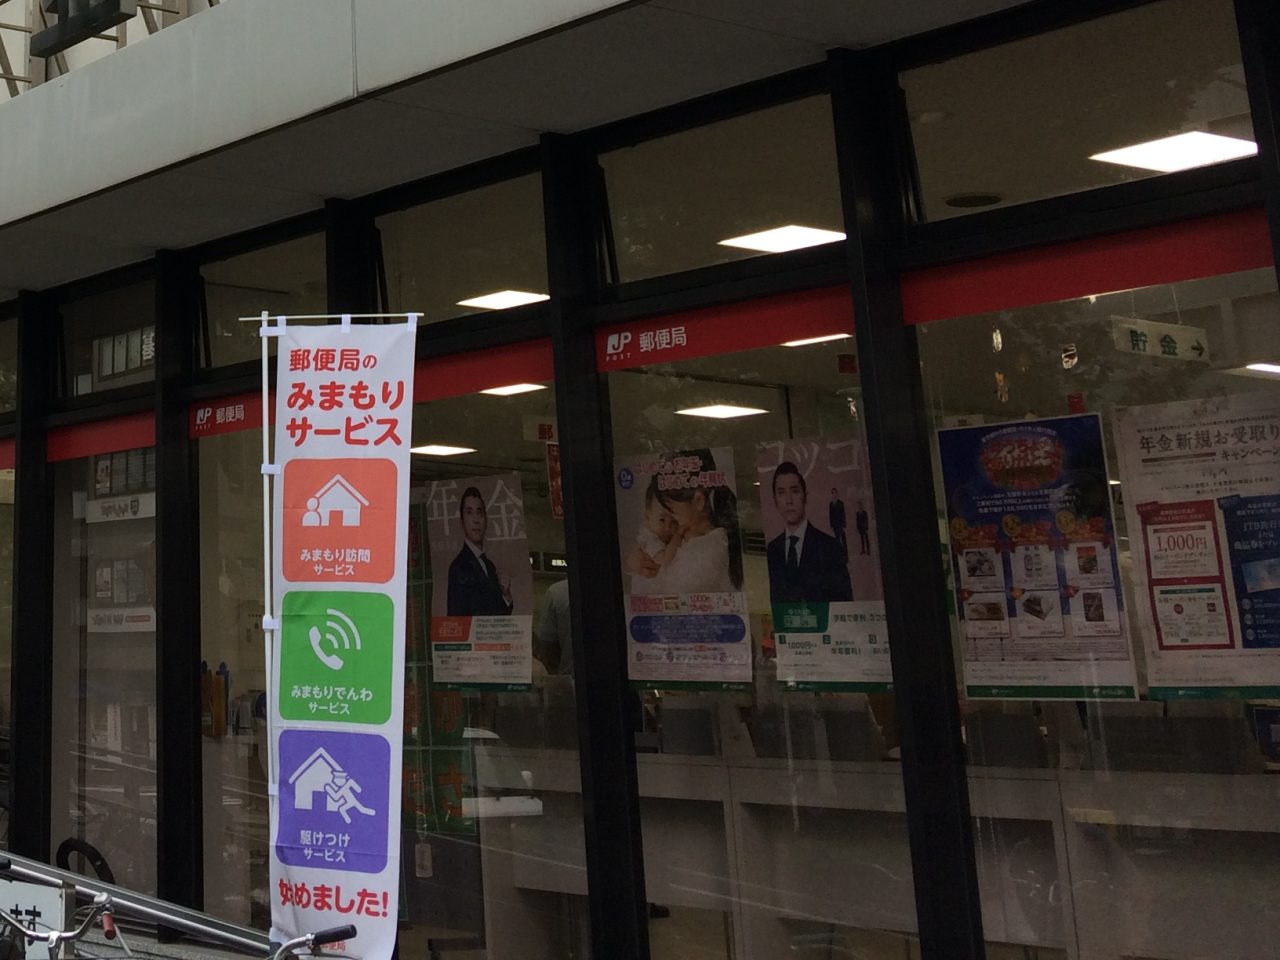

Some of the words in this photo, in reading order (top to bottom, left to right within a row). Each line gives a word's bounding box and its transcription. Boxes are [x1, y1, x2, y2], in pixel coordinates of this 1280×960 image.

[639, 326, 687, 352] 郵便局
[288, 347, 378, 372] 郵便局の
[286, 380, 405, 411] みまもり
[215, 404, 245, 425] 郵便局
[285, 414, 403, 448] サービス
[1156, 534, 1208, 553] 1,000円
[299, 548, 371, 563] みまもり訪問
[313, 563, 356, 577] サービス
[291, 685, 373, 702] みまもりでんわ
[308, 701, 351, 716] サービス
[299, 829, 351, 848] 駆けつけ
[303, 847, 347, 864] サービス
[278, 878, 389, 918] 始めました!
